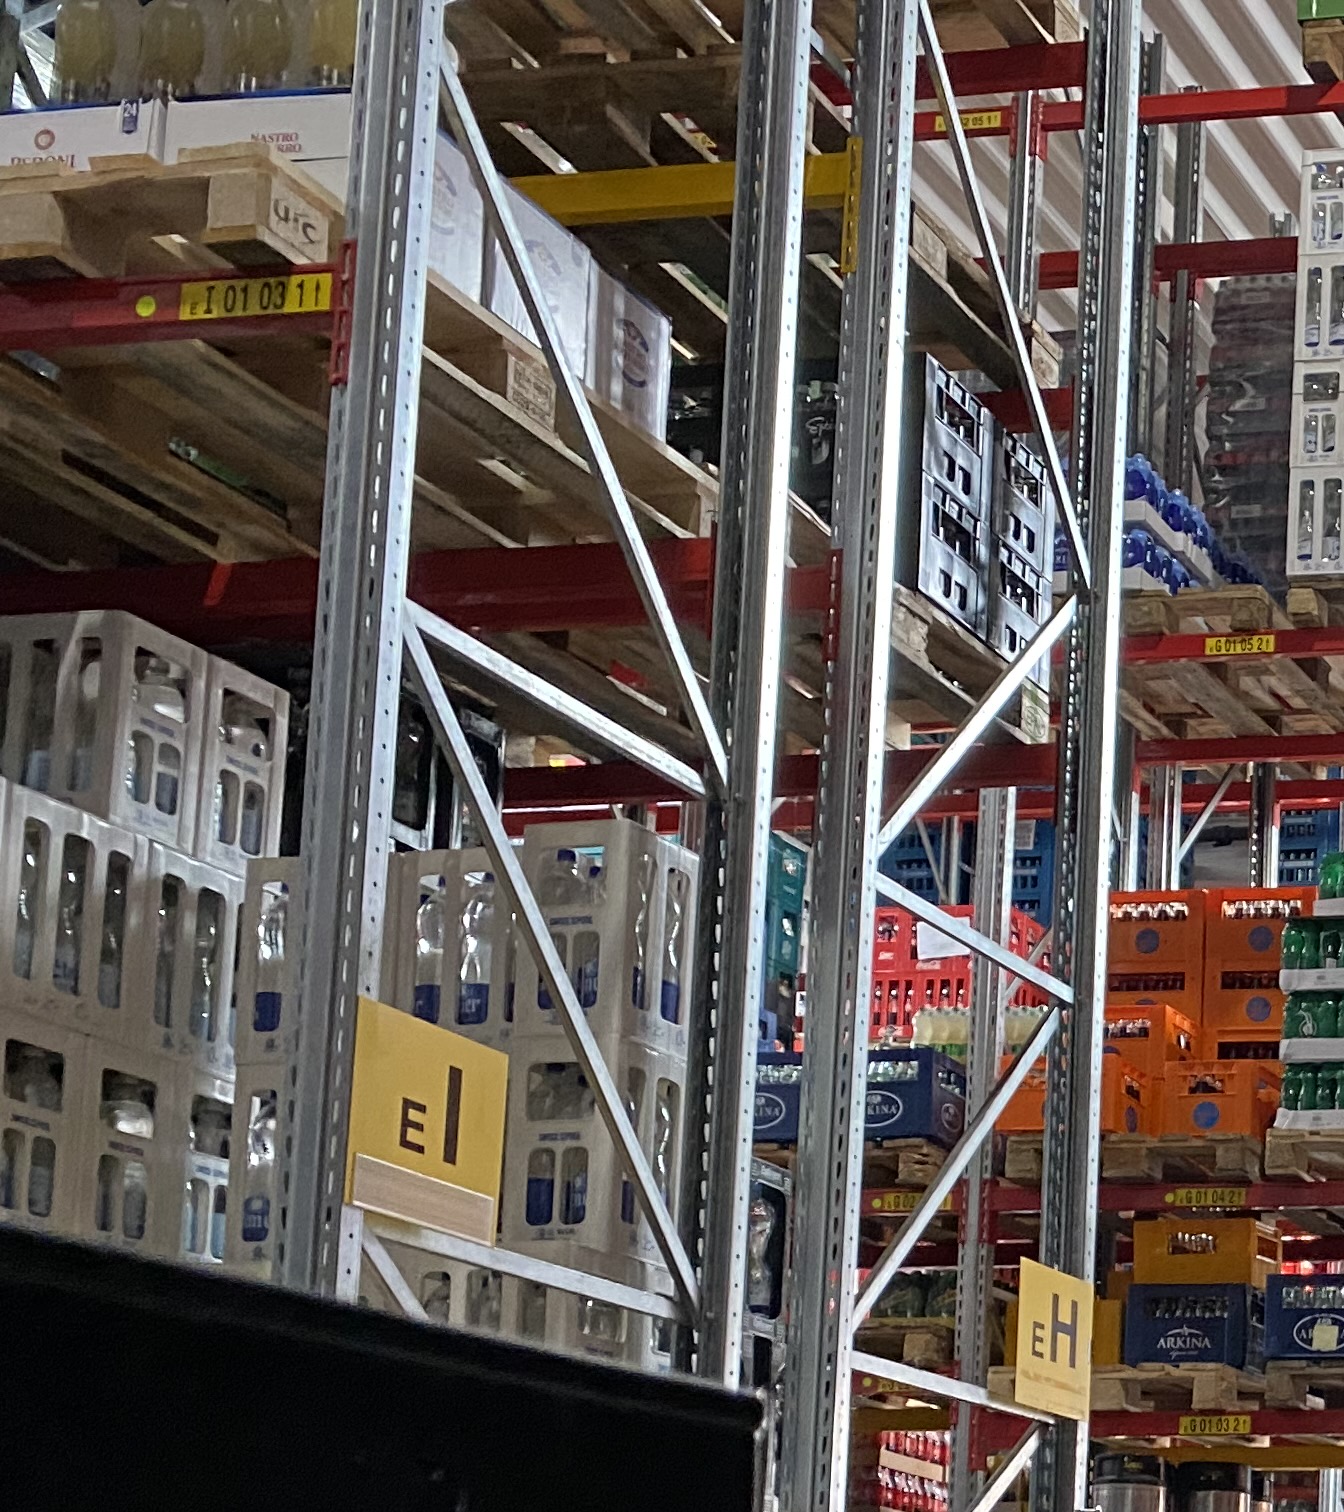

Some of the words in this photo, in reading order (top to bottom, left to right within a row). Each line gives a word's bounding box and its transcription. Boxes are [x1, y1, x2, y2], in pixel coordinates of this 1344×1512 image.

[251, 133, 299, 144] NASTRO
[224, 284, 249, 313] 01
[260, 280, 286, 311] 03
[866, 1105, 898, 1116] KINA
[1157, 1336, 1212, 1349] ARKINA
